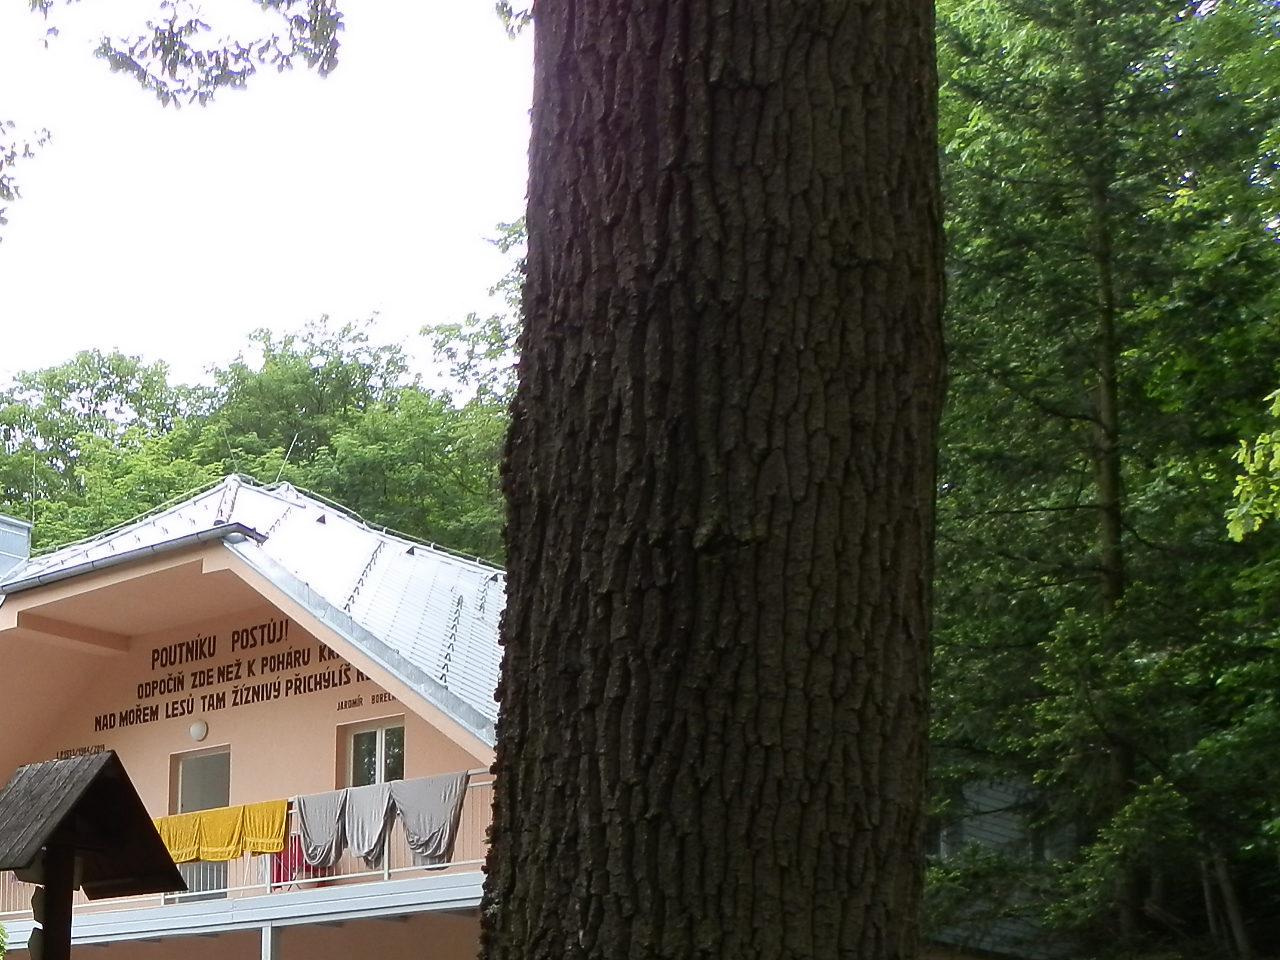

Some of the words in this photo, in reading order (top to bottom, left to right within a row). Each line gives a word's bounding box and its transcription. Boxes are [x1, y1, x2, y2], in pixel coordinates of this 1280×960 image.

[137, 670, 185, 700] ODPOČIŇ
[190, 668, 214, 690] ZDE
[217, 658, 242, 684] NEŽ
[247, 659, 256, 677] K
[261, 646, 311, 675] POHÁRU
[151, 633, 217, 670] POUTNÍKU
[94, 712, 116, 732] NAD
[119, 703, 159, 728] MOŘEM
[200, 691, 226, 713] TAM
[231, 676, 281, 708] ŽÍZNIVÝ
[285, 663, 352, 697] PŘICHÝLÍŠ
[336, 694, 363, 711] JAROMÍR
